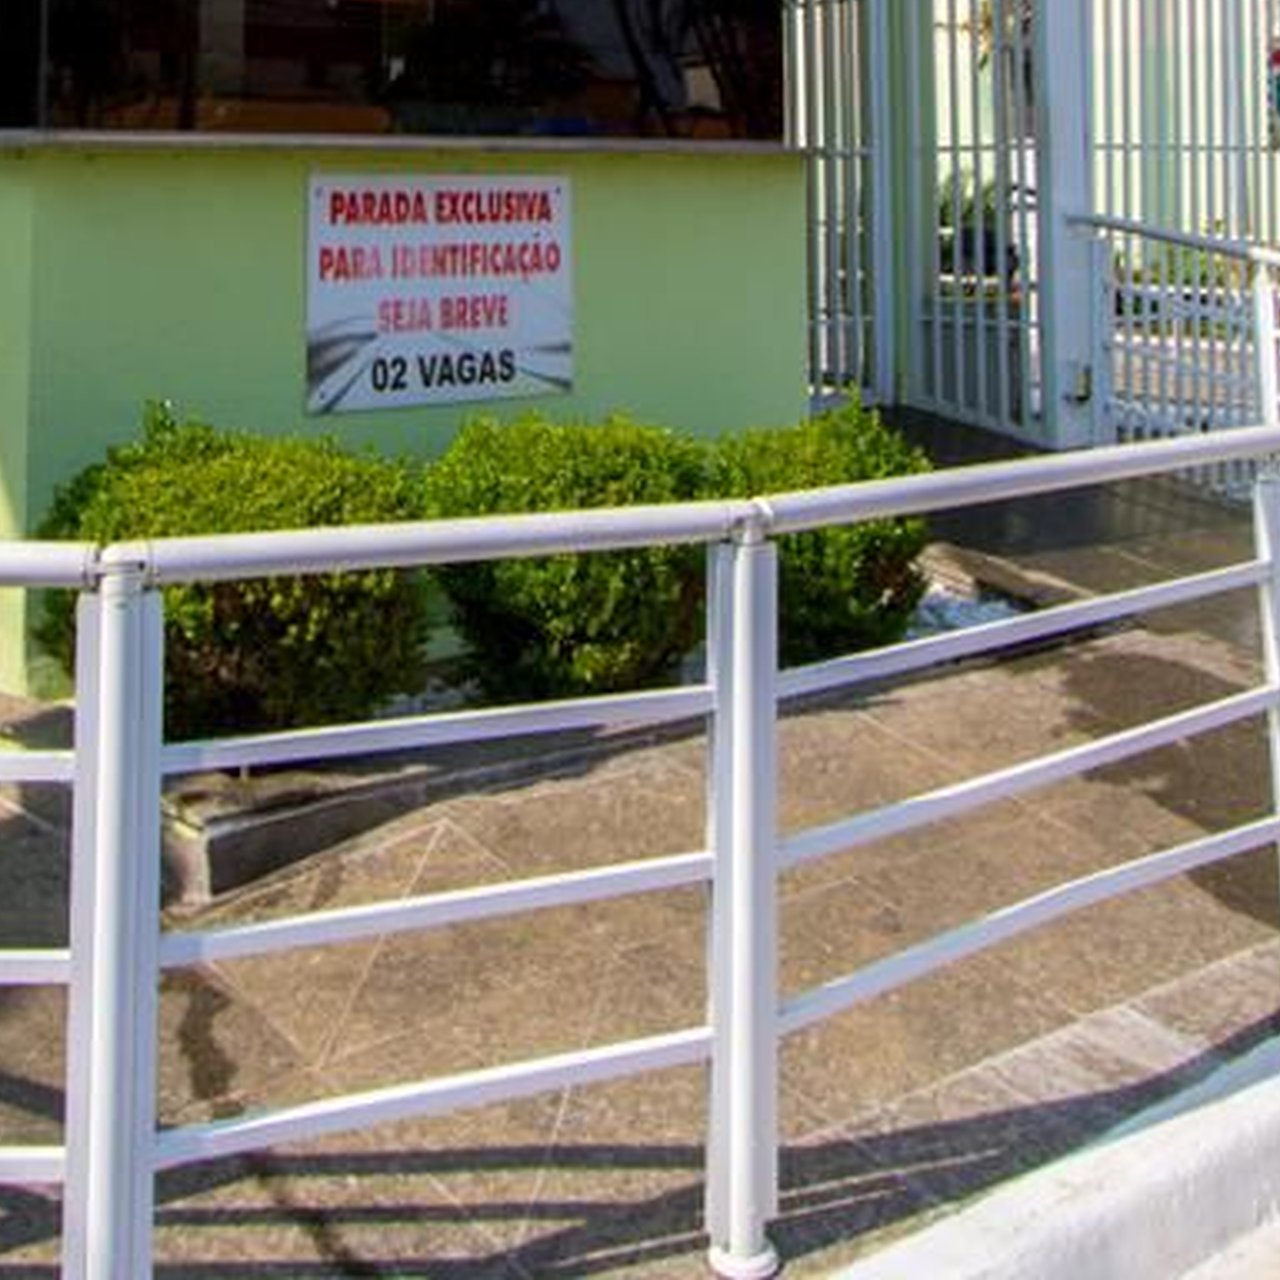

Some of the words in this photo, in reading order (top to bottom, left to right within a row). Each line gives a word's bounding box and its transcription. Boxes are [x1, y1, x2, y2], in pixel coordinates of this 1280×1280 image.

[329, 189, 428, 225] PARADA
[434, 189, 552, 224] EXCLUSIVA
[319, 245, 383, 282] PARA
[378, 298, 432, 333] SEJA
[439, 294, 509, 330] BREVE
[371, 357, 408, 392] 02
[417, 349, 517, 389] VAGAS
